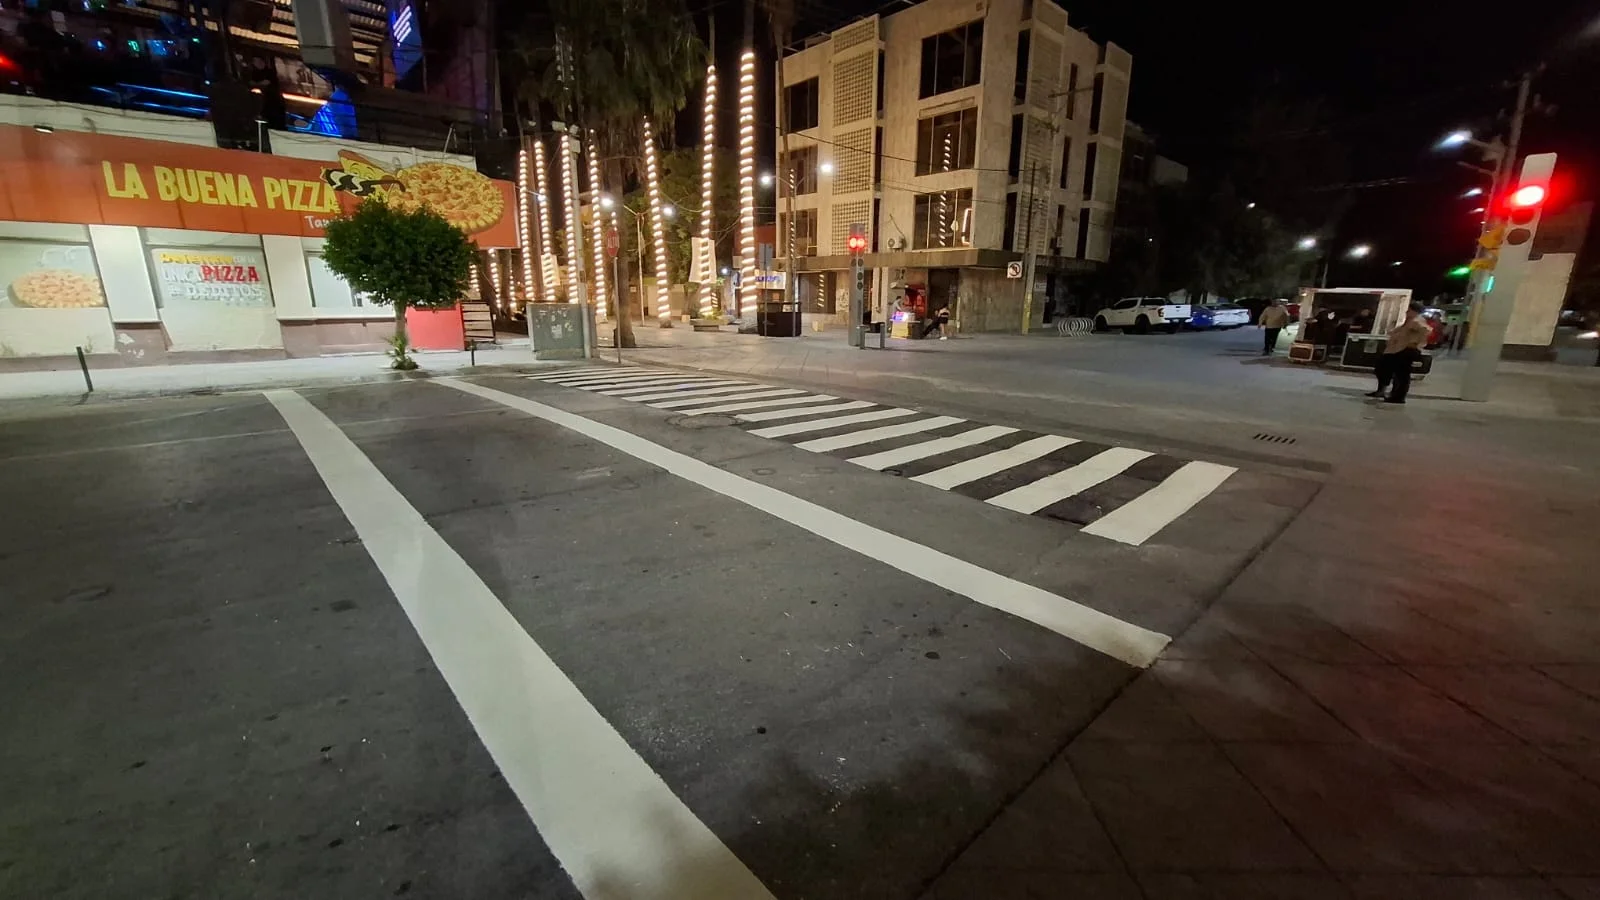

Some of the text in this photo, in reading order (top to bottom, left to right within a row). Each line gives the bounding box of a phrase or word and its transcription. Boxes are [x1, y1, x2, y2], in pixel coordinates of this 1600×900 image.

[102, 160, 341, 214] LA BUENA PIZZA
[200, 264, 260, 282] PIZZA
